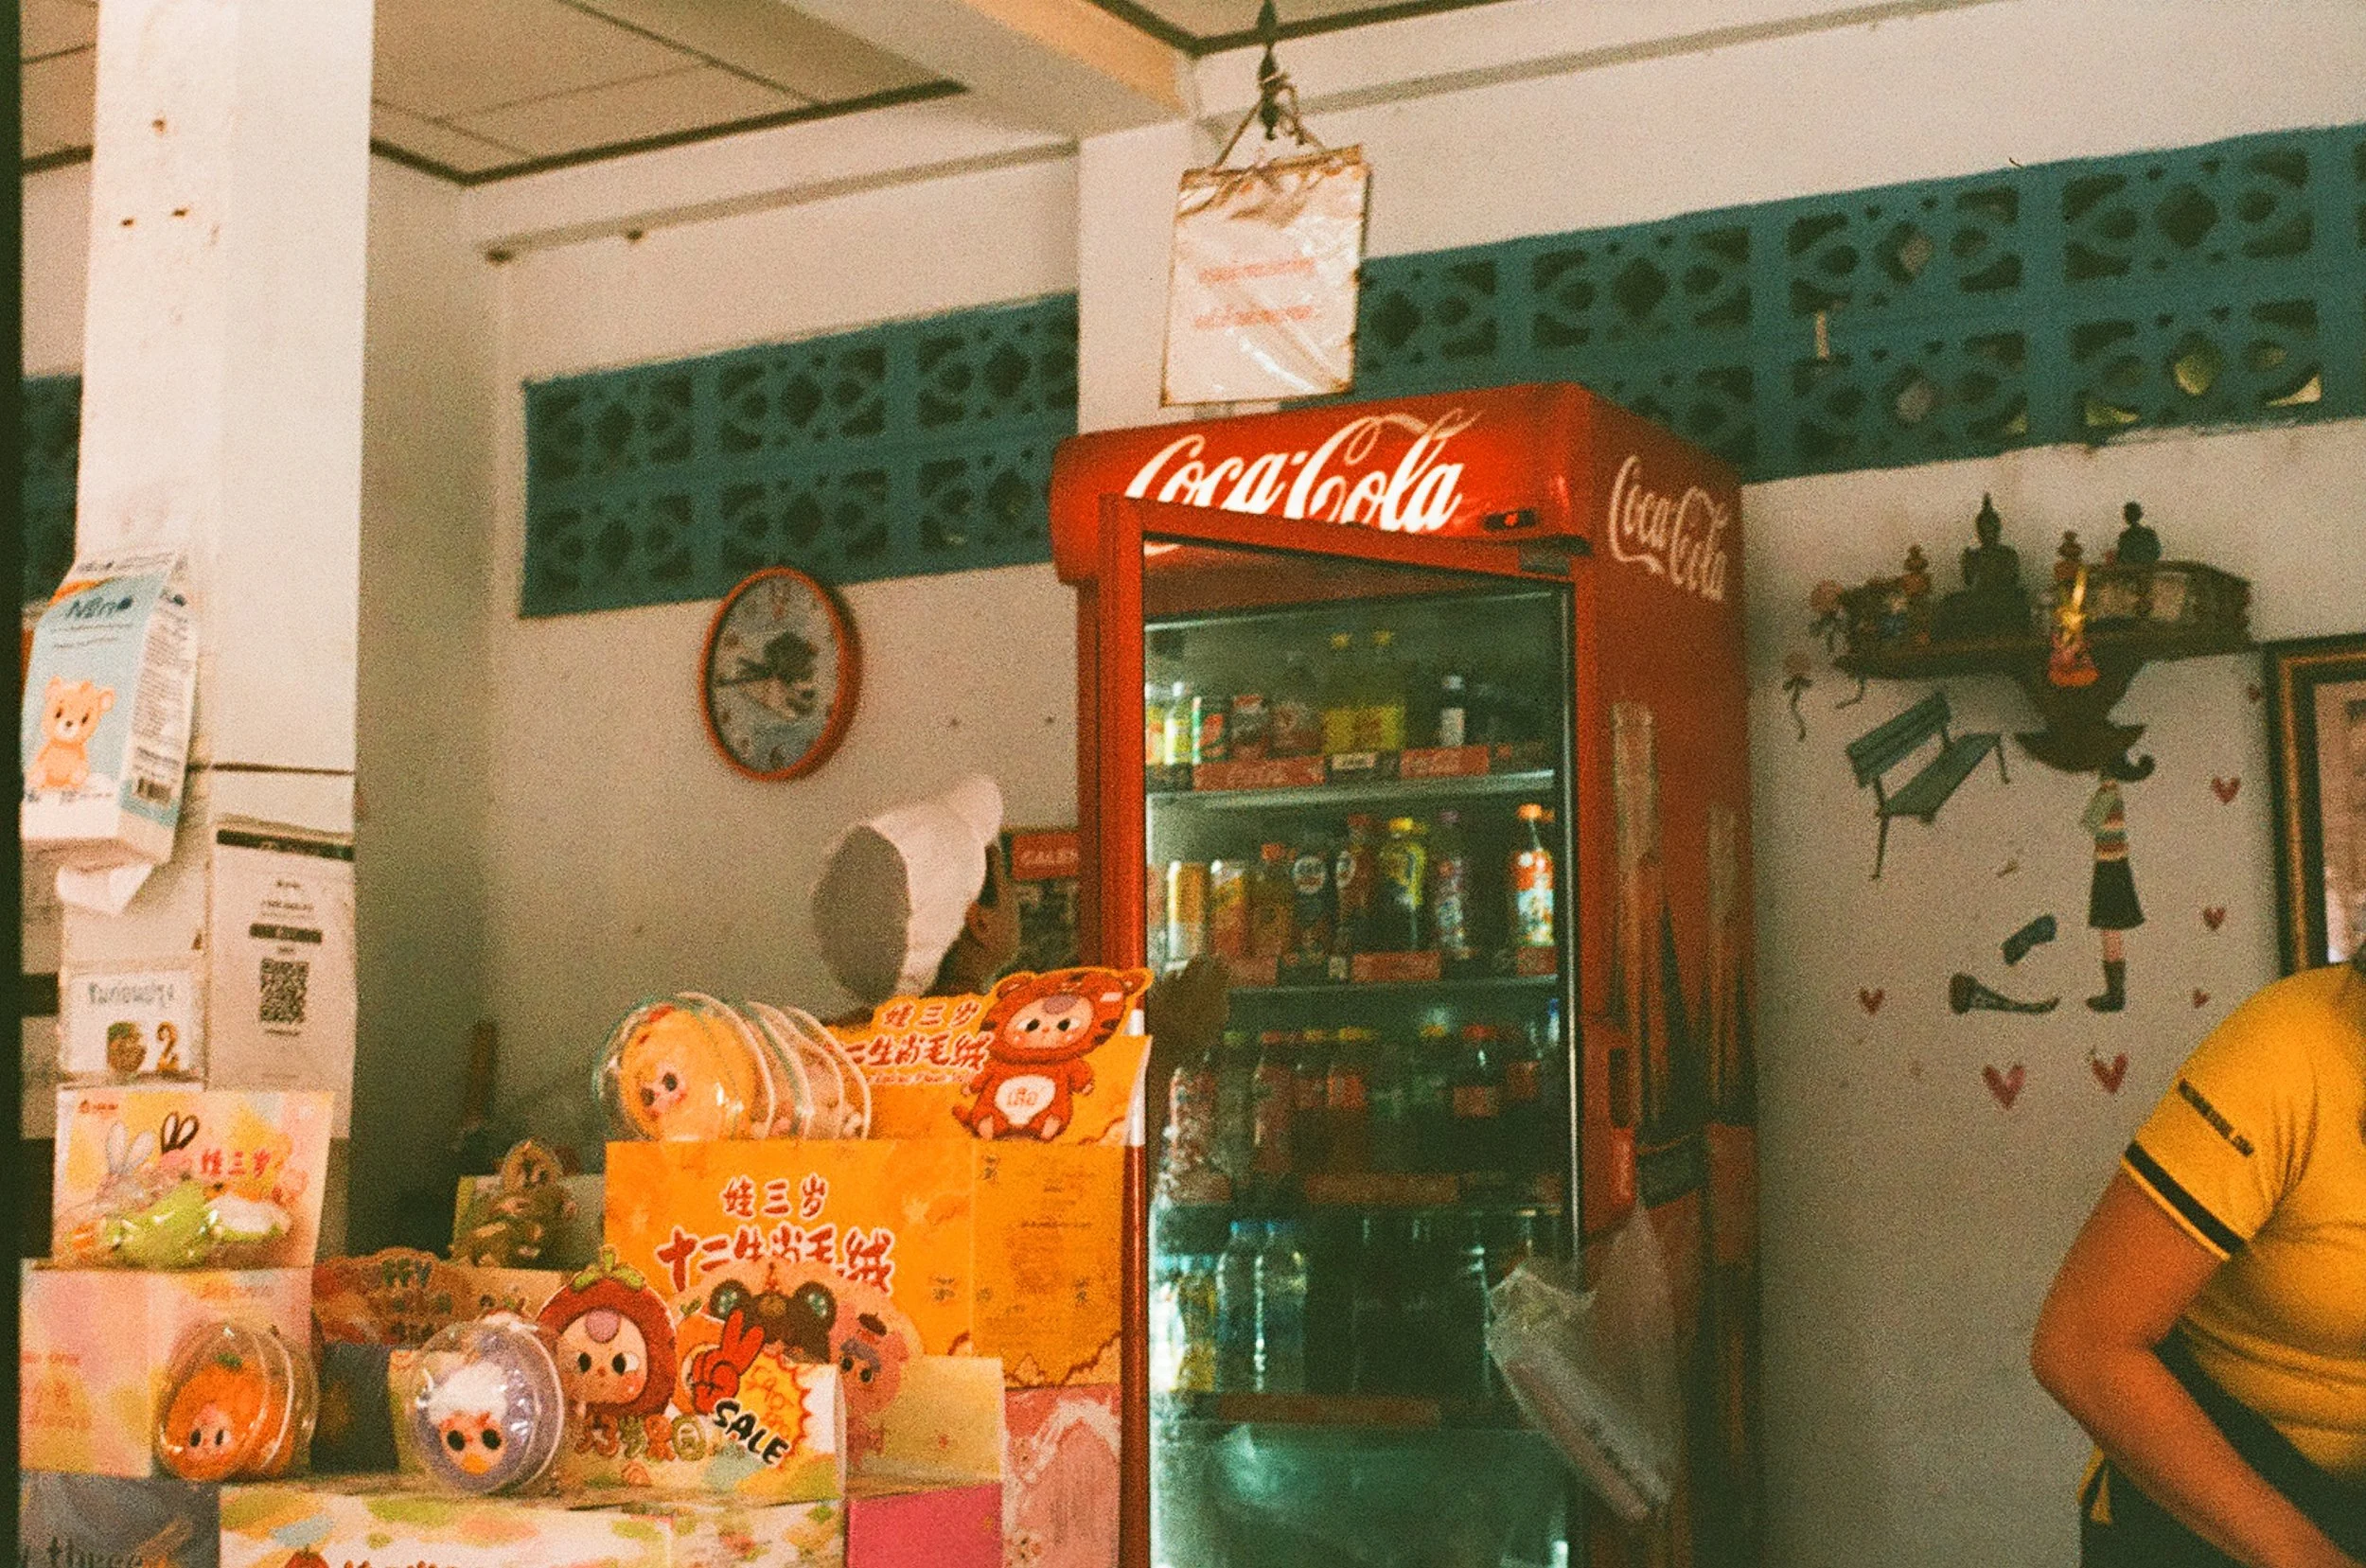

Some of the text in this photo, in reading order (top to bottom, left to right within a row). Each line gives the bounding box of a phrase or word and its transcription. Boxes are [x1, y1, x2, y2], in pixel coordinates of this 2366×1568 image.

[884, 1001, 980, 1029] 娃三岁
[841, 1031, 993, 1072] 二生肖毛绒
[722, 1175, 827, 1218] 娃三岁
[712, 1399, 791, 1466] SALE
